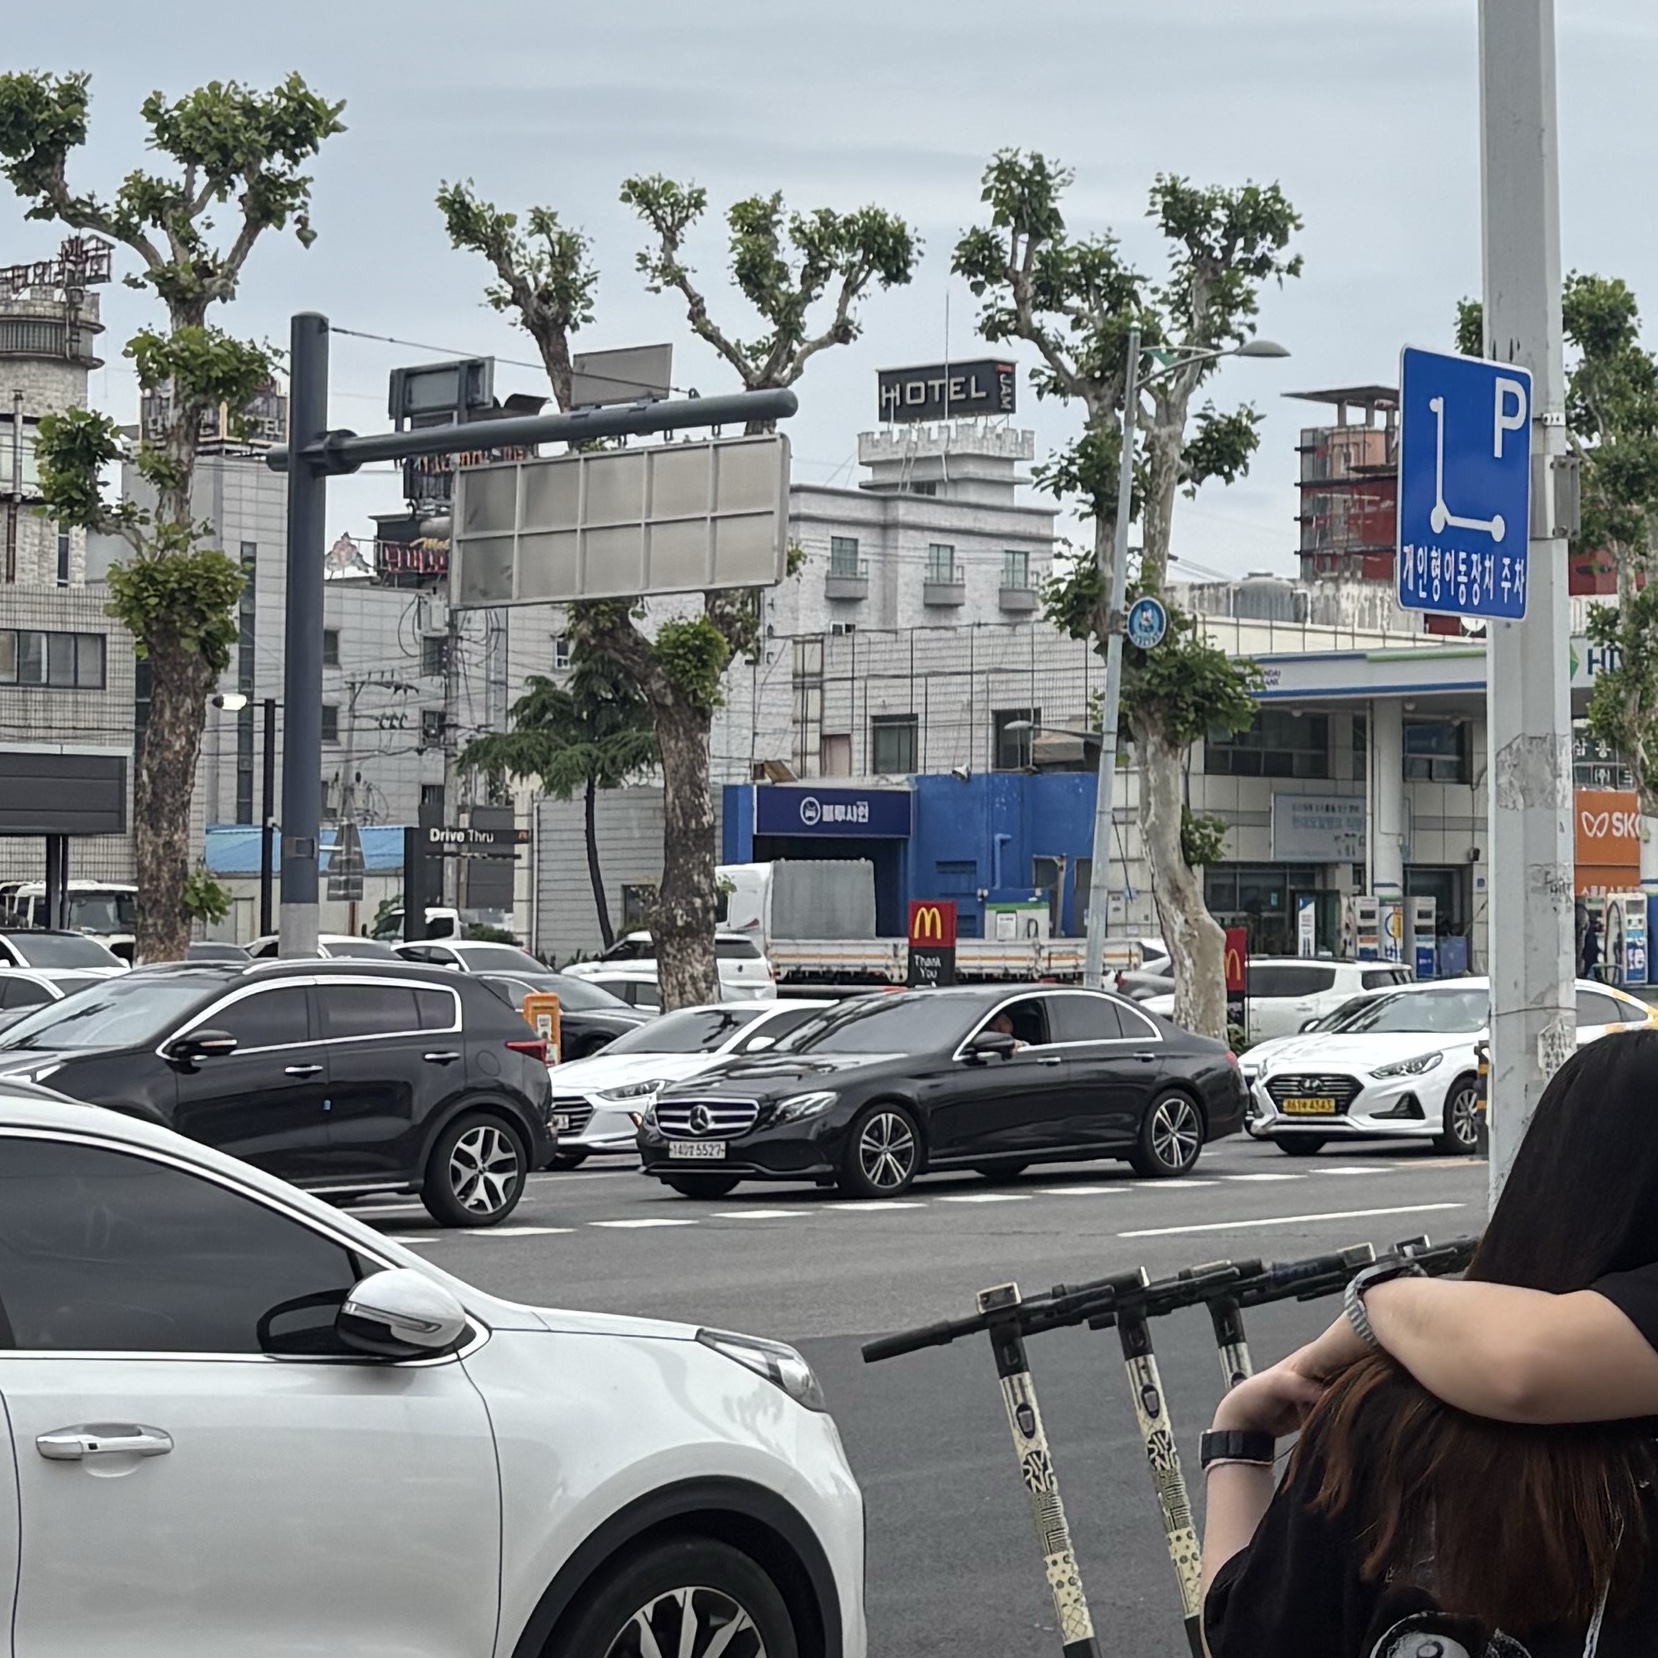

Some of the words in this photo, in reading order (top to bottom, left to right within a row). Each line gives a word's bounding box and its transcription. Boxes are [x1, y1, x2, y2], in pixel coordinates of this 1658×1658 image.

[881, 375, 987, 408] HOTEL
[1493, 376, 1528, 459] P
[1402, 543, 1494, 606] 개인형이동장치
[1501, 557, 1524, 604] 주차
[429, 828, 465, 842] Drive
[467, 829, 494, 843] Thru
